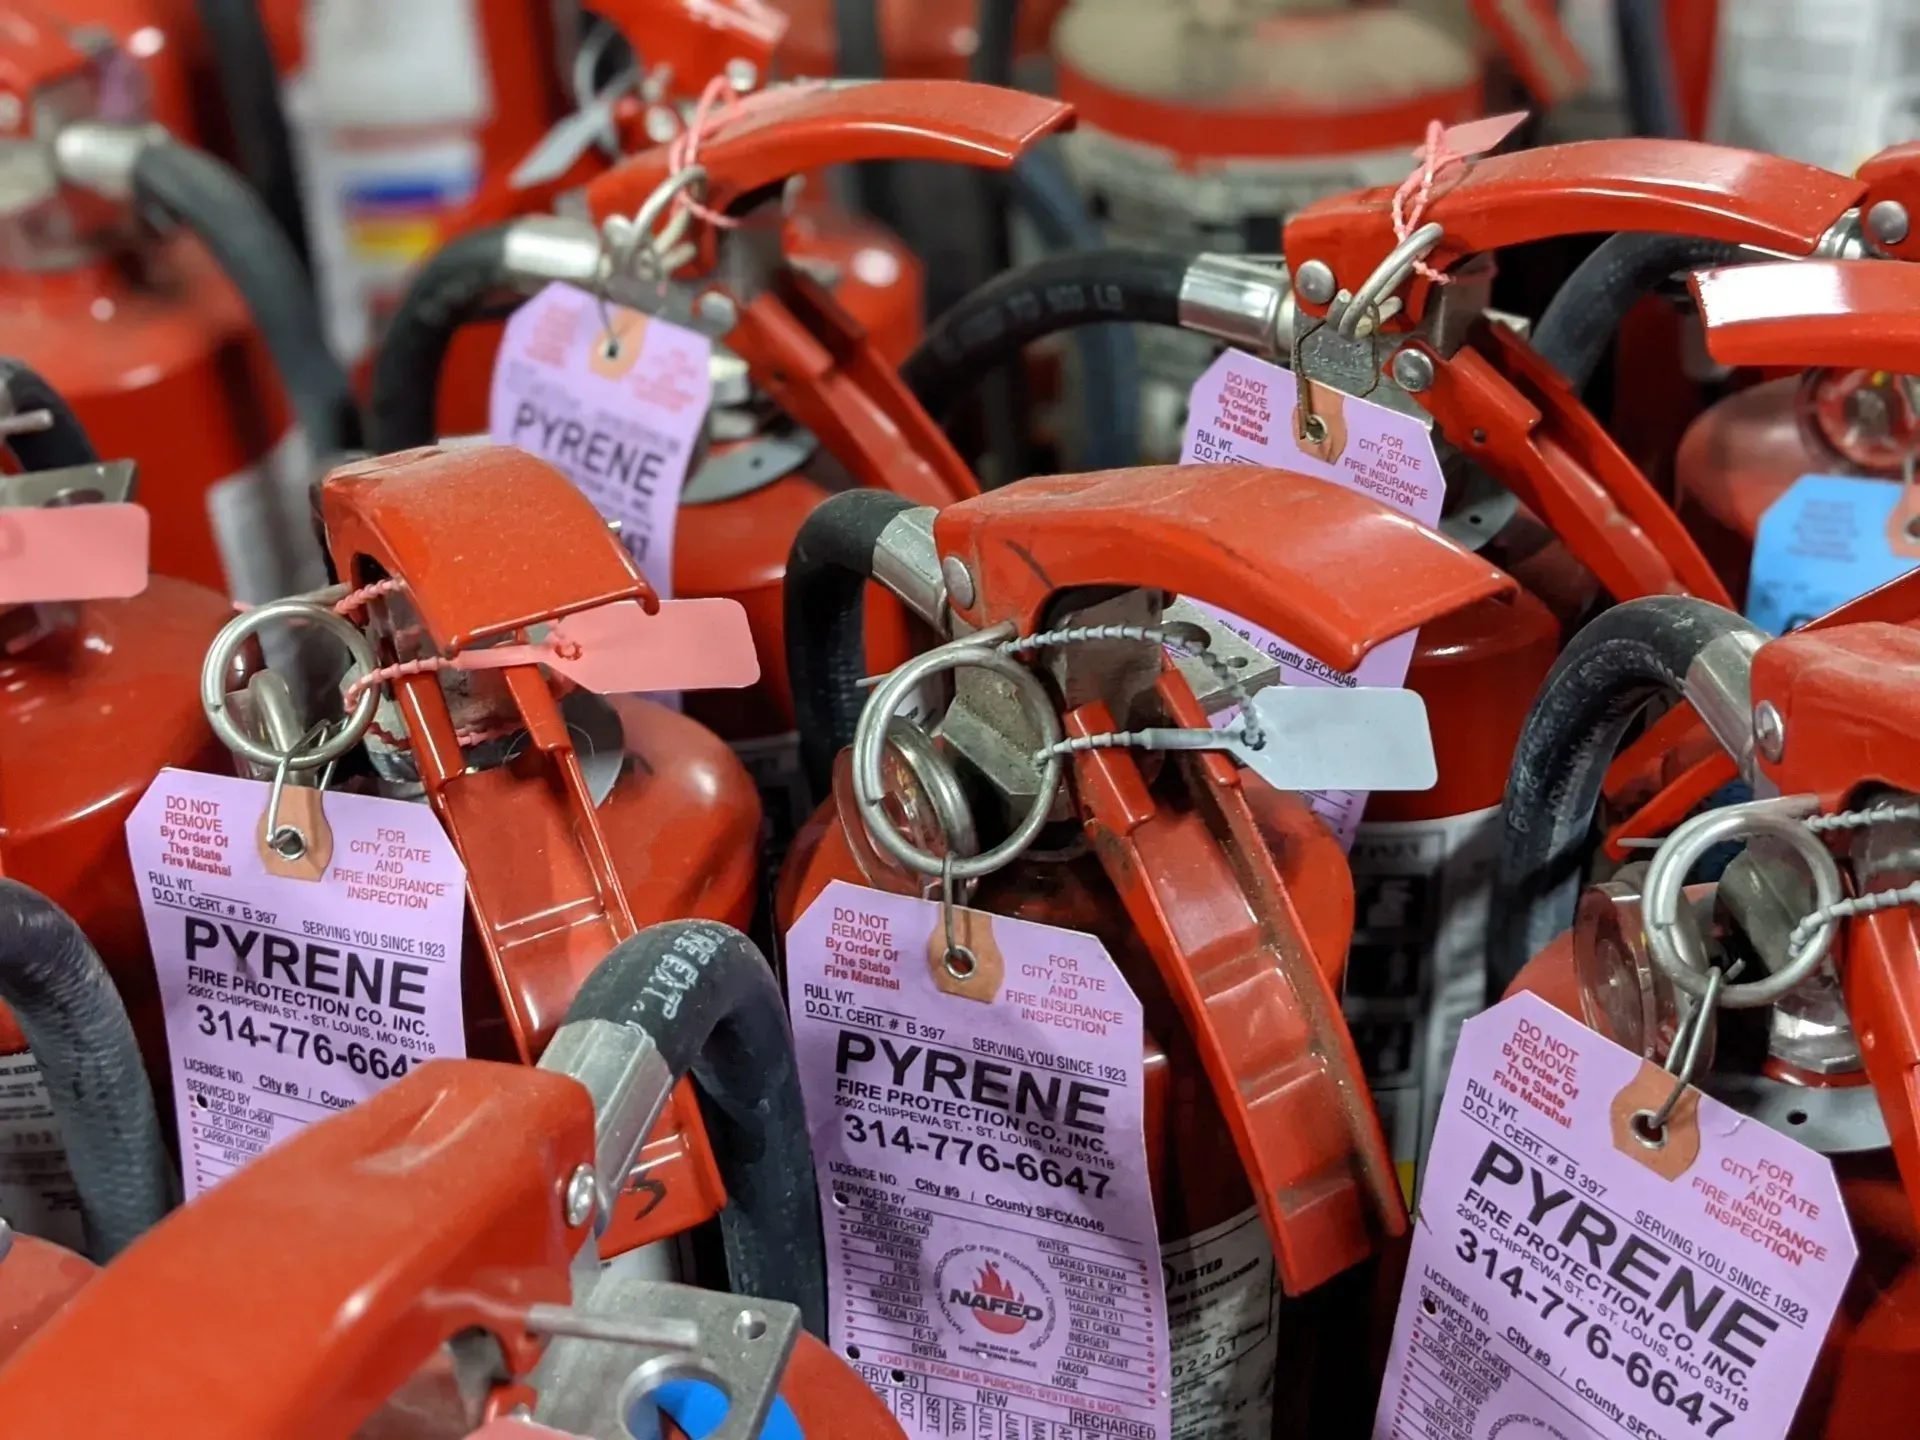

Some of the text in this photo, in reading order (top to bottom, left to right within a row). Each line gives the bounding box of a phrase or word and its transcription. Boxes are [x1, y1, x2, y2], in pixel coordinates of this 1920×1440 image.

[1224, 383, 1267, 410] REMOVE
[1214, 416, 1268, 445] Fire Marshal
[1380, 433, 1403, 448] FOR
[511, 402, 666, 497] PYRENE
[1359, 438, 1421, 470] CITY, STATE
[1345, 458, 1428, 499] FIRE INSURANCE
[1376, 458, 1398, 474] AND
[1355, 474, 1414, 507] INSPECTION
[1267, 642, 1357, 687] County SFCX4046
[166, 795, 219, 816] DO NOT
[165, 811, 222, 833] REMOVE
[377, 829, 405, 843] FOR
[160, 826, 228, 848] By Order Of
[351, 840, 430, 862] CITY, STATE
[163, 854, 231, 876] Fire Marshal
[170, 842, 221, 862] The State
[149, 872, 173, 888] FULL
[375, 860, 403, 874] AND
[333, 869, 444, 896] FIRE INSURANCE
[347, 885, 428, 909] INSPECTION
[834, 907, 888, 929] DO NOT
[303, 920, 445, 957] SERVING YOU SINCE 1923
[826, 937, 898, 961] By Order Of
[832, 924, 891, 946] REMOVE
[185, 916, 429, 1015] PYRENE
[833, 953, 890, 975] The State
[1049, 955, 1078, 971] FOR
[825, 966, 899, 990] Fire Marshal
[1022, 964, 1105, 992] CITY, STATE
[189, 967, 430, 1037] FIRE PROTECTION CO. INC.
[805, 984, 833, 1001] FULL
[1049, 985, 1077, 1000] AND
[187, 985, 436, 1054] 2902 CHIPPEWA ST. ST. LOUIS, MO 63118
[1006, 990, 1123, 1025] FIRE INSURANCE
[1022, 1008, 1107, 1036] INSPECTION
[1518, 1018, 1579, 1064] DO NOT
[973, 1037, 1126, 1081] SERVING YOU SINCE 1923
[1512, 1032, 1577, 1082] REMOVE
[835, 1030, 1110, 1134] PYRENE
[1502, 1043, 1579, 1100] By Order Of
[1493, 1070, 1572, 1129] Fire Marshal
[1507, 1063, 1565, 1109] The State
[1467, 1079, 1518, 1123] FULL WT.
[834, 1095, 864, 1112] 2902
[867, 1102, 941, 1129] CHIPPEWA
[943, 1119, 964, 1133] ST.
[976, 1125, 997, 1140] ST.
[1000, 1130, 1045, 1152] LOUIS,
[1049, 1141, 1072, 1157] MO
[837, 1078, 1109, 1154] FIRE PROTECTION CO. INC.
[844, 1114, 1110, 1199] 314-776-6647
[1462, 1095, 1607, 1198] D.O.T. CERT. # B 397
[1757, 1158, 1794, 1188] FOR
[1720, 1158, 1820, 1220] CITY, STATE
[1747, 1190, 1782, 1217] AND
[1692, 1176, 1828, 1262] FIRE INSURANCE
[1037, 1239, 1069, 1254] WATER
[1704, 1202, 1803, 1267] INSPECTION
[1048, 1256, 1126, 1280] LOADED STREAM
[1471, 1140, 1780, 1368] PYRENE
[1634, 1210, 1809, 1324] SERVING YOU SINCE 1923
[1177, 1258, 1223, 1285] LISTED
[1464, 1188, 1749, 1392] FIRE PROTECTION CO. INC.
[949, 1289, 1043, 1320] NAFED
[1420, 1285, 1491, 1347] SERVICED BY
[1457, 1204, 1749, 1412] 2902 CHIPPEWA ST. ST. LOUIS, MO 63118
[1069, 1332, 1109, 1349] INERGEN
[1070, 1317, 1121, 1336] WET CHEM
[1456, 1227, 1735, 1439] 314-776-6647
[1065, 1345, 1129, 1369] CLEAN AGENT
[1424, 1264, 1625, 1424] LICENSE NO. City #9 County
[1058, 1360, 1088, 1375] FM200
[1052, 1376, 1078, 1389] HOSE
[977, 1390, 1008, 1407] NEW
[1074, 1411, 1156, 1439] RECHARGED
